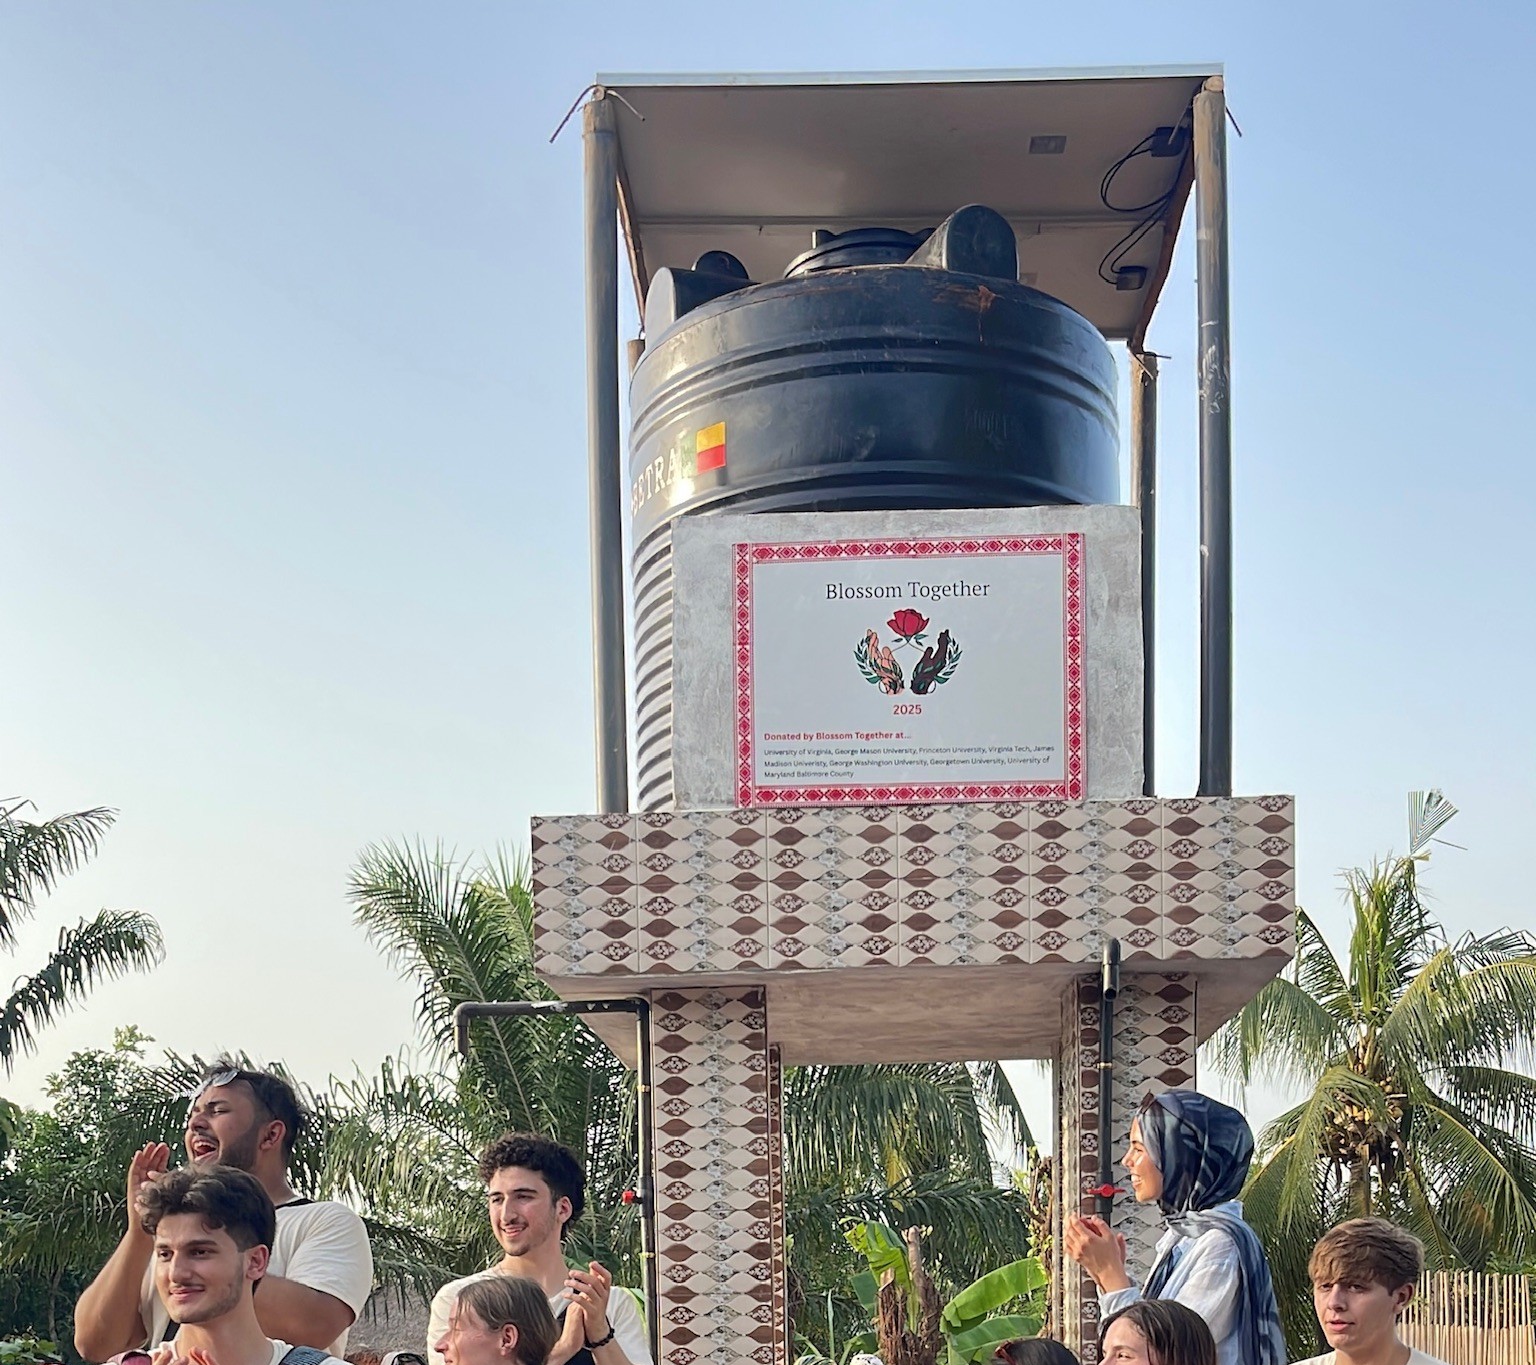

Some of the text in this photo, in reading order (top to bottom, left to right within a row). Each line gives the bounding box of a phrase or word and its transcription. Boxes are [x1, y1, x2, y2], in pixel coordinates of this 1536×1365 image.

[826, 580, 990, 602] Blossom Together
[893, 704, 922, 715] 2025
[764, 733, 801, 741] Donated
[803, 732, 814, 742] by
[816, 731, 853, 740] Blossom
[855, 731, 893, 741] Together
[835, 748, 858, 756] George
[883, 748, 918, 756] University,
[989, 746, 1013, 754] Virginia
[1014, 745, 1032, 753] Tech,
[854, 759, 893, 767] Washington
[894, 759, 929, 767] University,
[930, 758, 970, 766] Georgetown
[971, 757, 1006, 766] University,
[1008, 757, 1041, 765] University
[1042, 756, 1050, 764] of
[764, 771, 795, 779] Maryland
[829, 770, 854, 778] County
